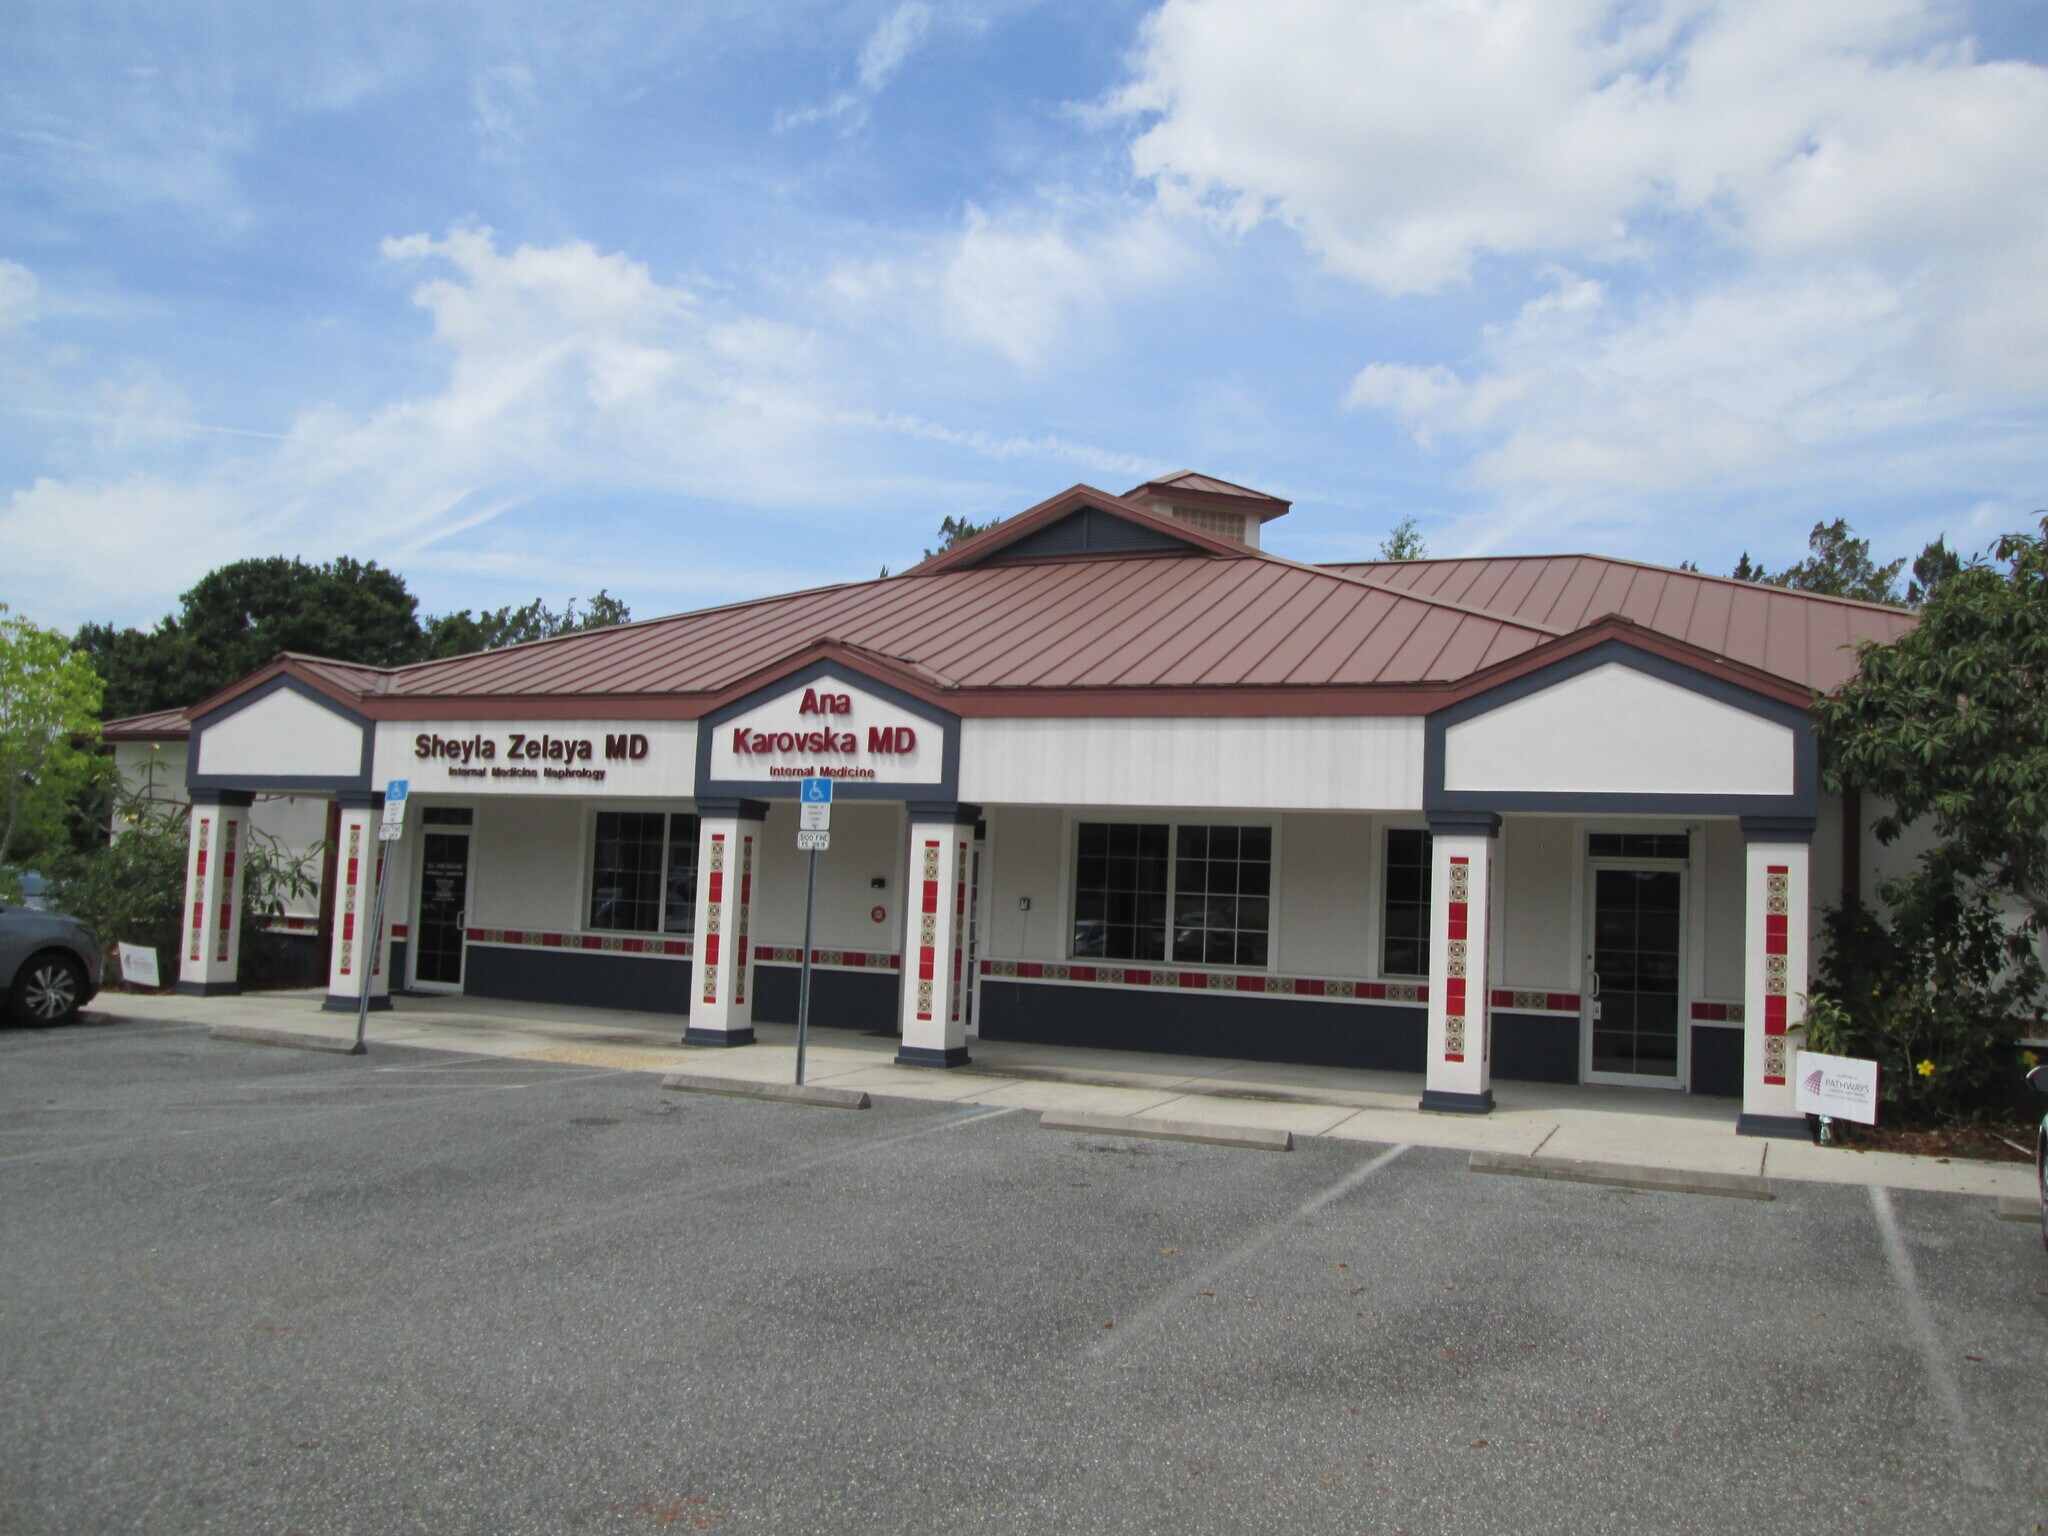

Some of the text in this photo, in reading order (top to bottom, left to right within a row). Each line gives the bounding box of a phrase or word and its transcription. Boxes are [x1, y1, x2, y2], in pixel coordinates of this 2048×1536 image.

[799, 688, 851, 714] Ana
[415, 733, 649, 764] Sheyla Zelaya MD
[733, 726, 916, 754] Karovska MD
[448, 766, 606, 781] Internal Medicine Nephrology
[769, 766, 875, 778] Internal Medicine
[1825, 1079, 1870, 1094] PATHWAYS
